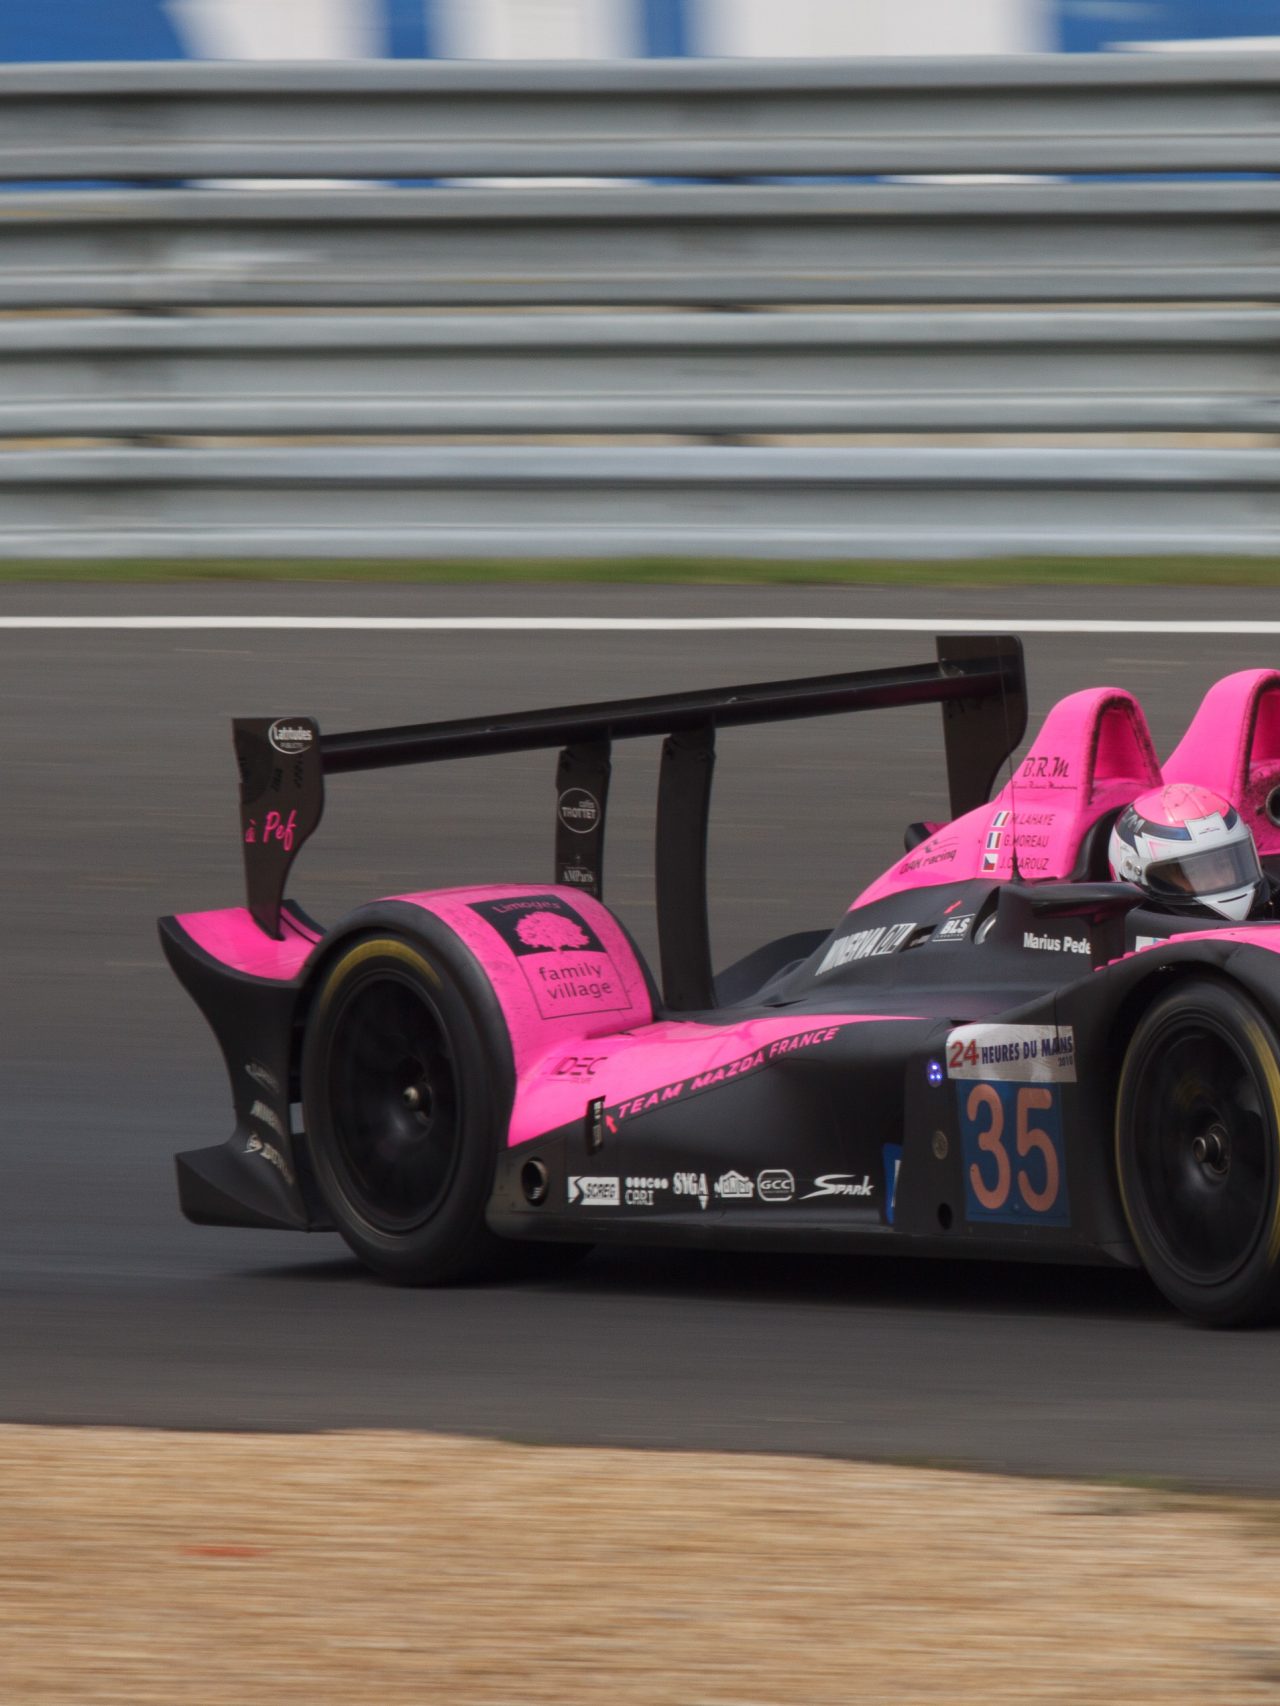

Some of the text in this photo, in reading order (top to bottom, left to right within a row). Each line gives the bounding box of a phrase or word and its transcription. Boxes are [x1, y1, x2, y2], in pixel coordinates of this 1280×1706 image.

[263, 809, 296, 851] Pef
[1000, 856, 1049, 871] J.CAROUZ
[940, 917, 971, 934] BLS
[1023, 932, 1060, 951] Marius
[539, 962, 602, 982] family
[547, 981, 613, 999] village
[950, 1036, 1073, 1068] 24 HEURES DU MANS
[618, 1027, 840, 1119] TEAM MAZDA FRANCE
[967, 1084, 1059, 1212] 35
[760, 1179, 791, 1190] GCC
